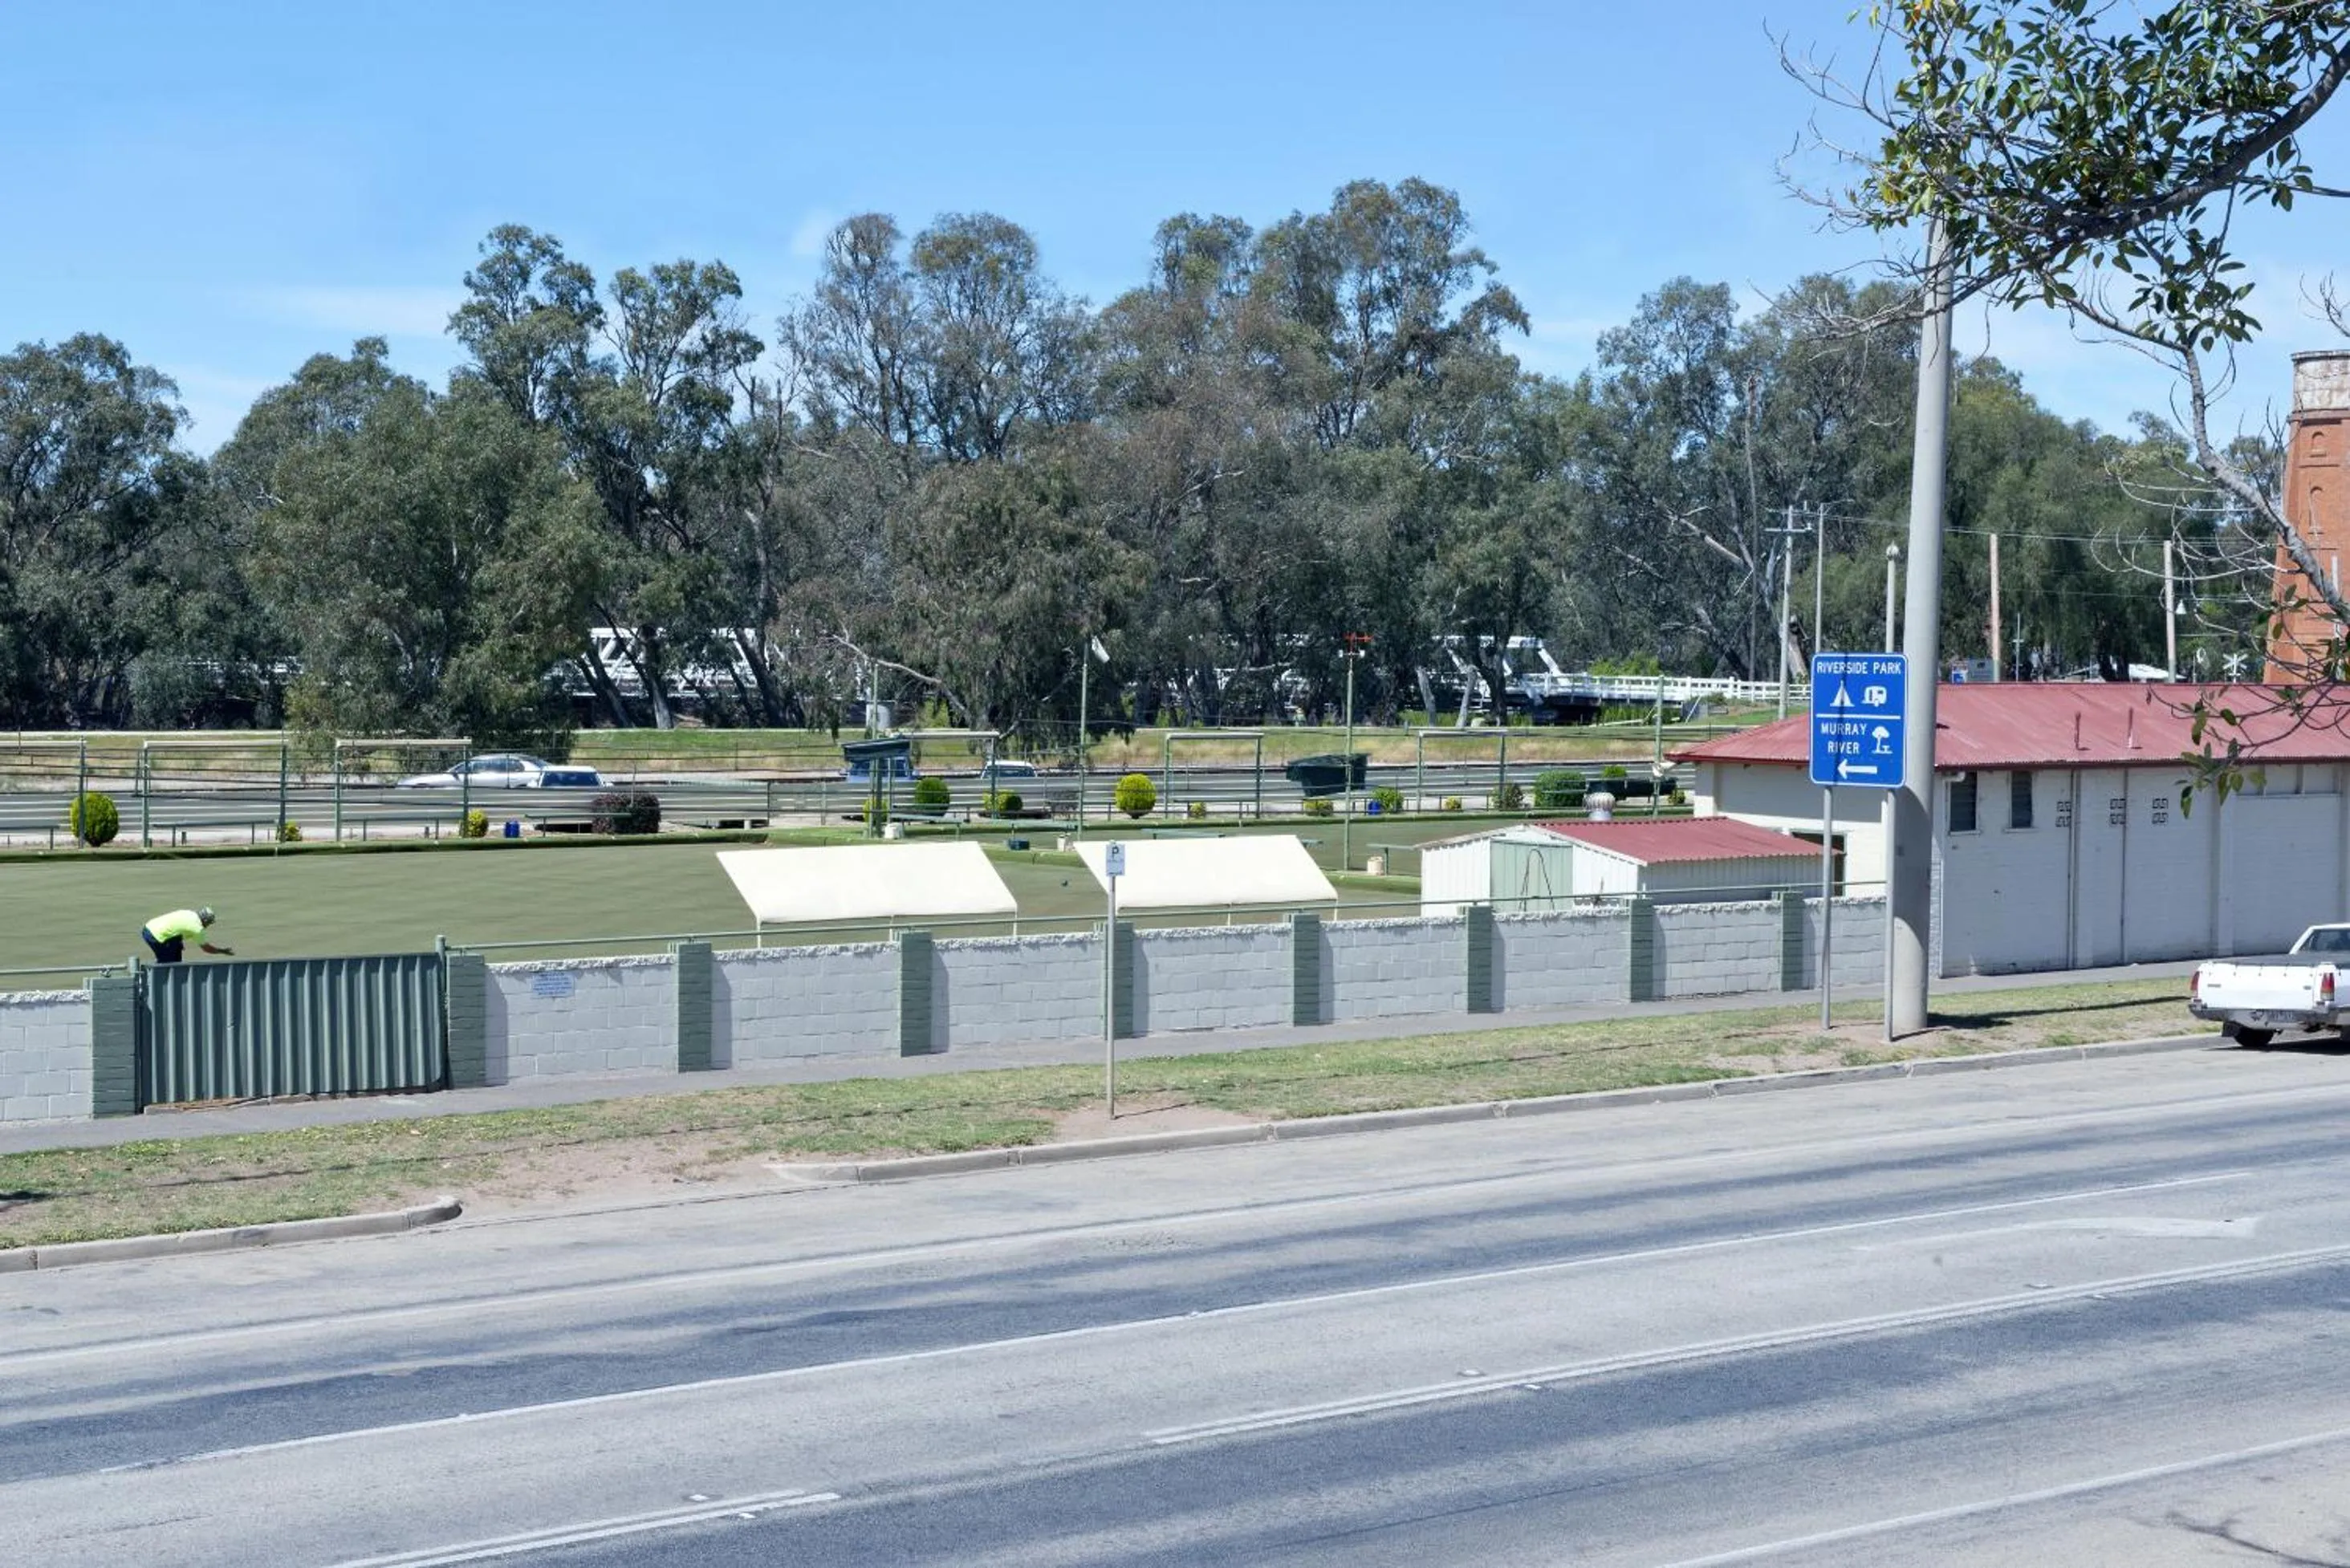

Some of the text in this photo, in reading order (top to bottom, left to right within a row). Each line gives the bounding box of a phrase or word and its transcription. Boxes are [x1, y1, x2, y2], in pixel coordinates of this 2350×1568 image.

[1816, 661, 1901, 674] RIVERSIDE PARK
[1821, 723, 1868, 736] MURRAY
[1828, 741, 1860, 754] RIVER
[1112, 846, 1119, 859] P
